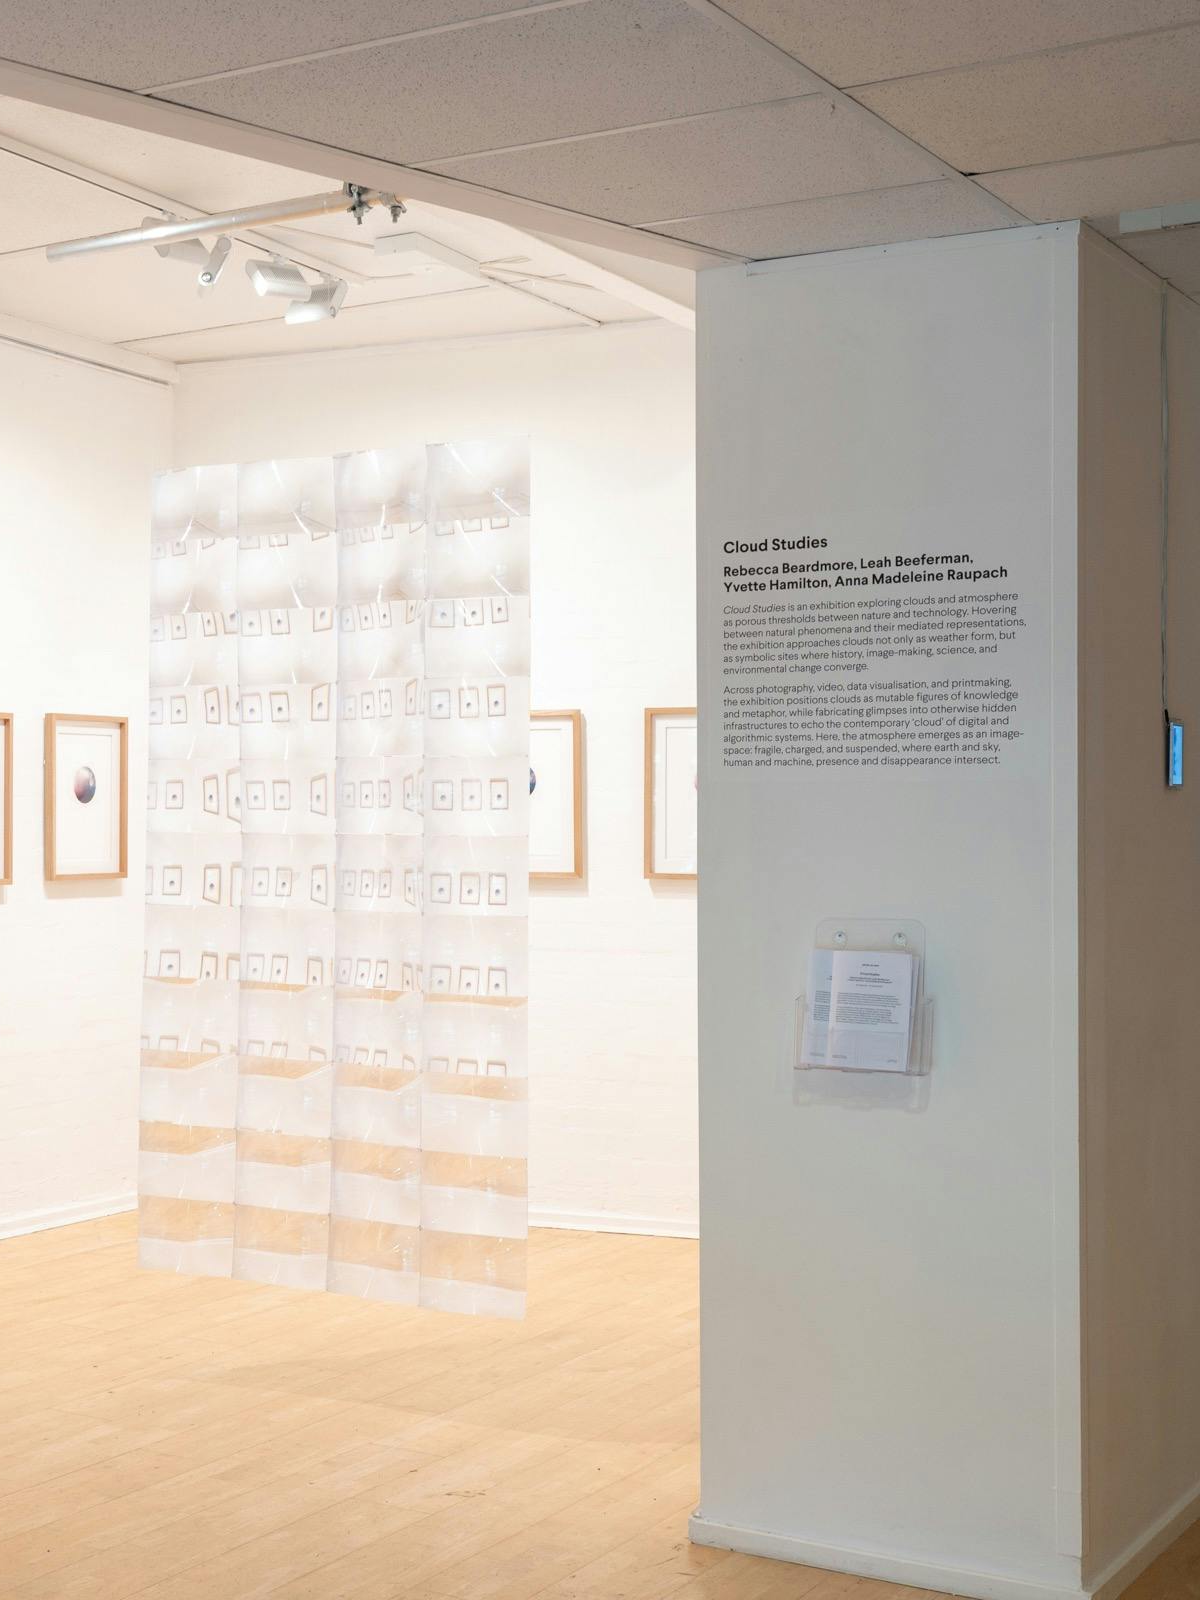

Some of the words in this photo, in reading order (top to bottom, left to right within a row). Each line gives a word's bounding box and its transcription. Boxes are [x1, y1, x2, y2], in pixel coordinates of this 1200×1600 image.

[723, 538, 768, 553] Cloud
[772, 536, 828, 550] Studies
[723, 564, 779, 577] Rebecca
[781, 560, 857, 573] Beardmore,
[860, 555, 892, 568] Leah
[894, 553, 974, 566] Beeferman,
[724, 580, 766, 592] Yvette
[770, 576, 831, 590] Hamilton,
[835, 575, 868, 586] Anna
[872, 570, 943, 584] Madeleine
[948, 566, 1007, 581] Raupach
[723, 604, 751, 614] Cloud
[752, 603, 786, 613] Studies
[787, 603, 795, 611] is
[809, 600, 855, 610] exhibition
[857, 598, 902, 609] exploring
[902, 596, 936, 605] clouds
[937, 594, 956, 604] and
[958, 592, 1019, 603] atmosphere
[735, 618, 766, 628] porous
[768, 614, 816, 624] thresholds
[817, 613, 859, 622] between
[861, 611, 891, 620] nature
[892, 609, 910, 618] and
[912, 607, 969, 618] technology.
[971, 605, 1017, 615] Hovering
[723, 630, 763, 638] between
[765, 627, 795, 637] natural
[797, 626, 852, 637] phenomena
[854, 623, 871, 633] and
[873, 623, 895, 632] their
[897, 620, 943, 631] mediated
[946, 618, 1026, 630] representations,
[723, 642, 738, 651] the
[739, 640, 784, 650] exhibition
[786, 638, 840, 650] approaches
[842, 636, 873, 646] clouds
[875, 636, 891, 644] not
[893, 634, 914, 645] only
[928, 632, 968, 642] weather
[970, 632, 997, 641] form,
[999, 630, 1016, 639] but
[735, 652, 775, 664] symbolic
[777, 652, 798, 660] sites
[800, 650, 829, 660] where
[979, 644, 997, 653] and
[723, 664, 787, 674] environmental
[788, 663, 822, 674] change
[723, 685, 754, 694] Across
[846, 682, 867, 690] data
[930, 679, 949, 688] and
[723, 697, 738, 706] the
[740, 696, 784, 706] exhibition
[786, 696, 828, 706] positions
[830, 694, 861, 703] clouds
[875, 692, 914, 702] mutable
[916, 692, 948, 703] figures
[950, 691, 961, 700] of
[963, 690, 1018, 701] knowledge
[723, 709, 740, 718] and
[789, 707, 813, 717] while
[815, 707, 864, 717] fabricating
[865, 706, 907, 717] glimpses
[909, 706, 928, 714] into
[930, 704, 979, 713] otherwise
[981, 703, 1016, 712] hidden
[723, 721, 787, 730] infrastructures
[789, 721, 799, 729] to
[800, 720, 824, 729] echo
[826, 719, 841, 728] the
[843, 719, 910, 729] contemporary
[945, 717, 956, 726] of
[958, 716, 988, 727] digital
[990, 716, 1009, 725] and
[723, 733, 773, 744] algorithmic
[774, 733, 814, 743] systems.
[842, 731, 857, 740] the
[859, 730, 916, 741] atmosphere
[918, 732, 960, 740] emerges
[989, 730, 1024, 739] image-
[826, 744, 843, 753] and
[845, 743, 900, 754] suspended,
[901, 743, 932, 752] where
[934, 742, 959, 752] earth
[961, 742, 980, 751] and
[723, 758, 753, 766] human
[754, 757, 772, 766] and
[815, 759, 860, 767] presence
[861, 756, 879, 765] and
[880, 756, 952, 766] disappearance
[954, 756, 1000, 764] intersect.
